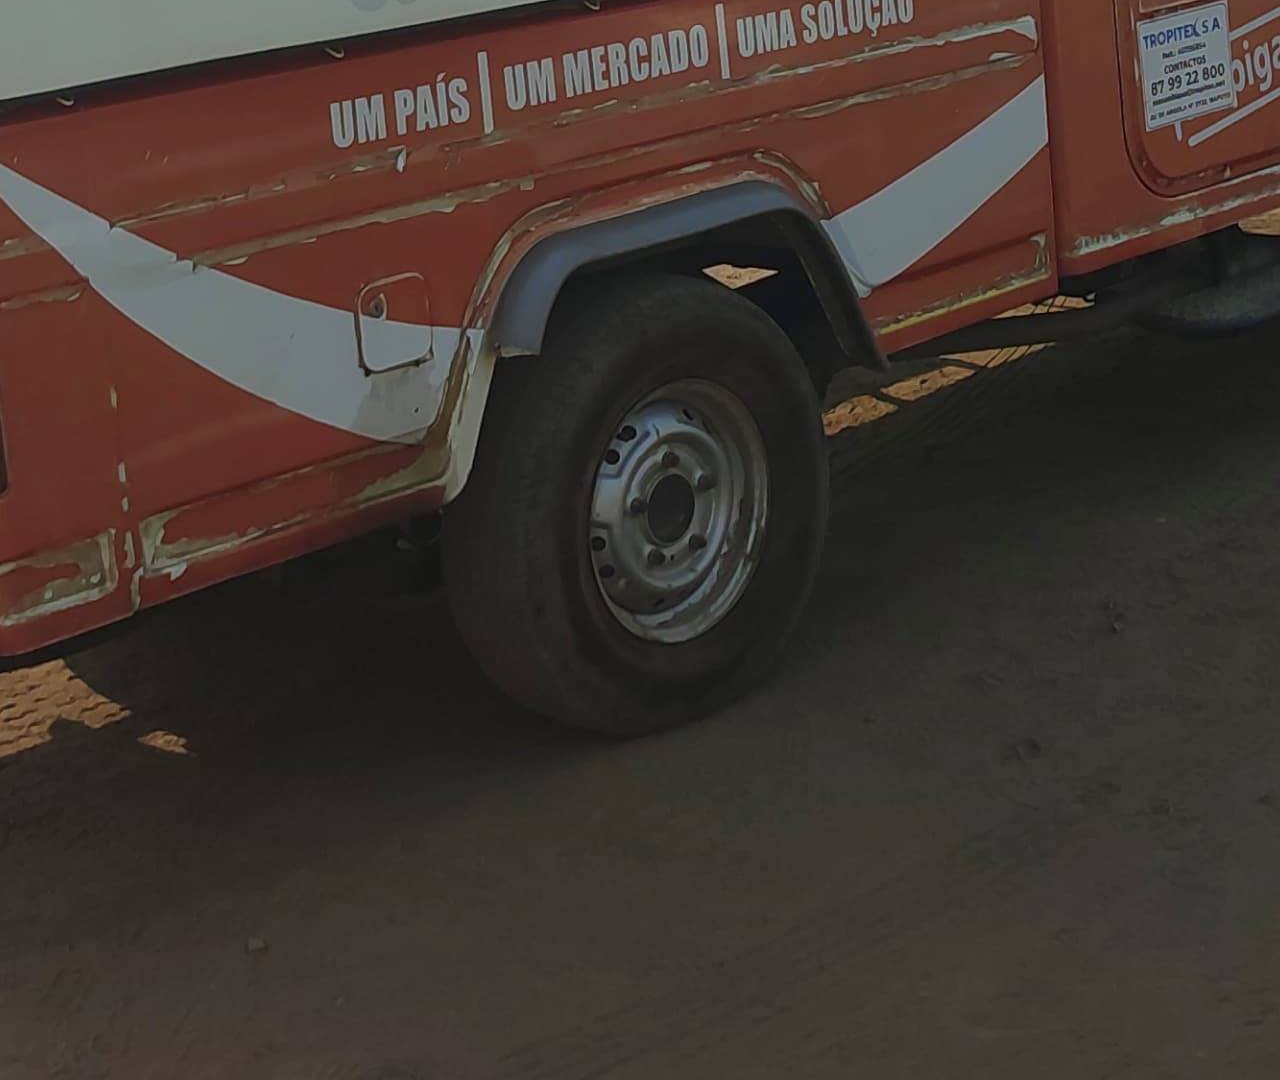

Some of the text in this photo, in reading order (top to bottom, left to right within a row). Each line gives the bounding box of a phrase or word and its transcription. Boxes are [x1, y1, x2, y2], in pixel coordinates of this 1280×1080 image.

[330, 94, 387, 148] UM
[394, 72, 470, 136] PAÍS
[503, 52, 557, 111] UM
[563, 24, 710, 96] MERCADO
[736, 7, 797, 58] UMA
[1151, 79, 1165, 96] 87
[1167, 74, 1182, 91] 99
[1185, 70, 1200, 86] 22
[1202, 63, 1225, 81] 800
[1164, 55, 1207, 74] CONTACTOS
